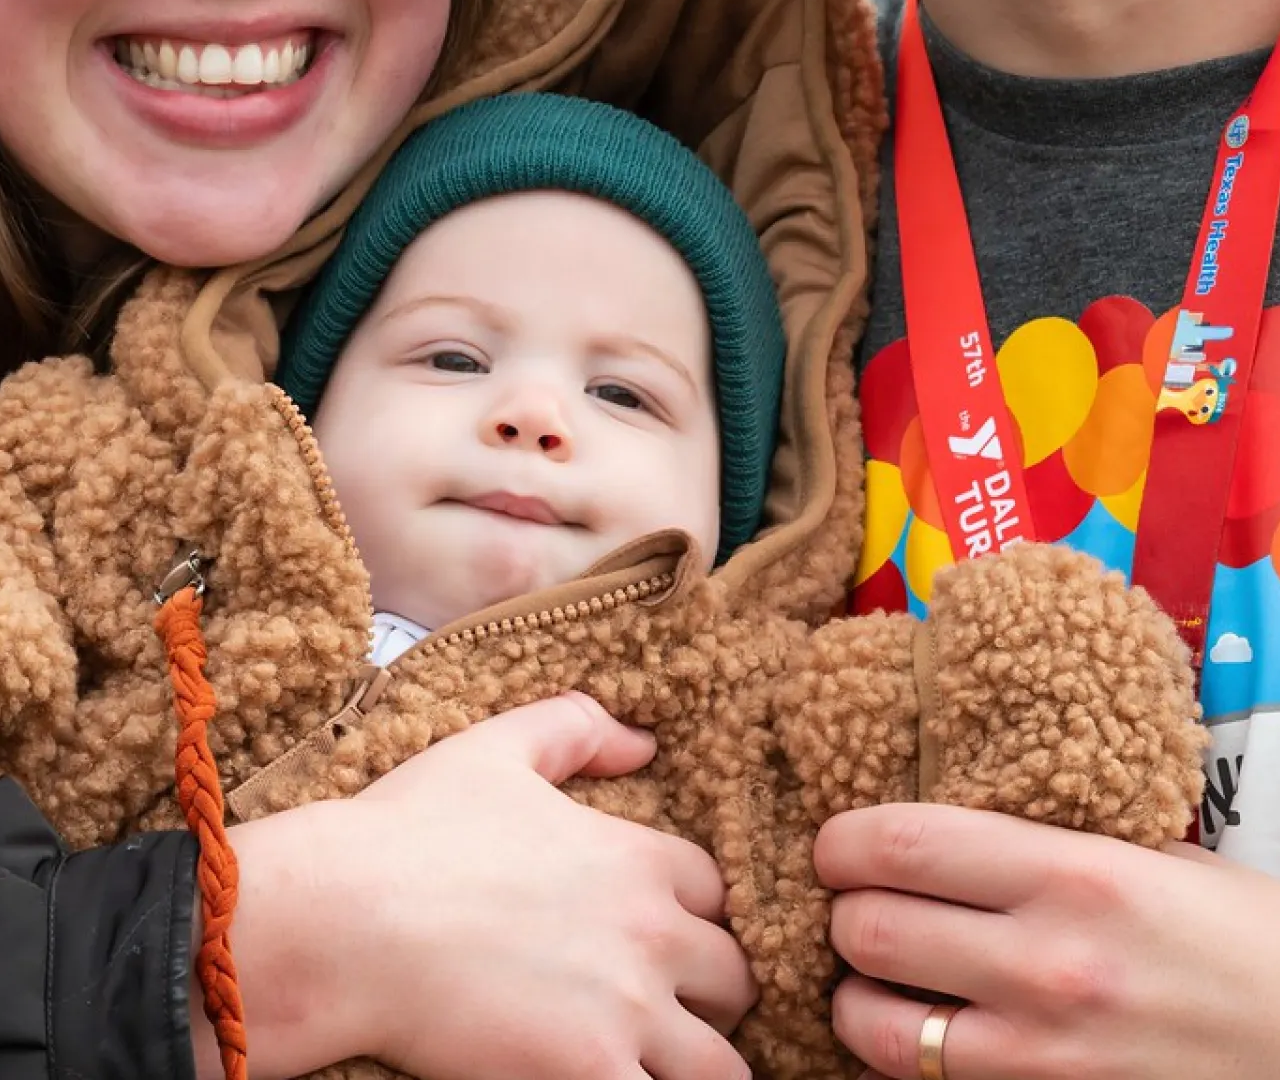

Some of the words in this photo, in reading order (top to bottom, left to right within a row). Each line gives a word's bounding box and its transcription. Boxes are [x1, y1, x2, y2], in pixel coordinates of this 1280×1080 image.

[1214, 151, 1244, 216] Texas
[1195, 220, 1229, 295] Health
[960, 331, 988, 387] 57th
[958, 409, 971, 432] the
[954, 480, 993, 560] TUR
[984, 469, 1023, 555] DALL
